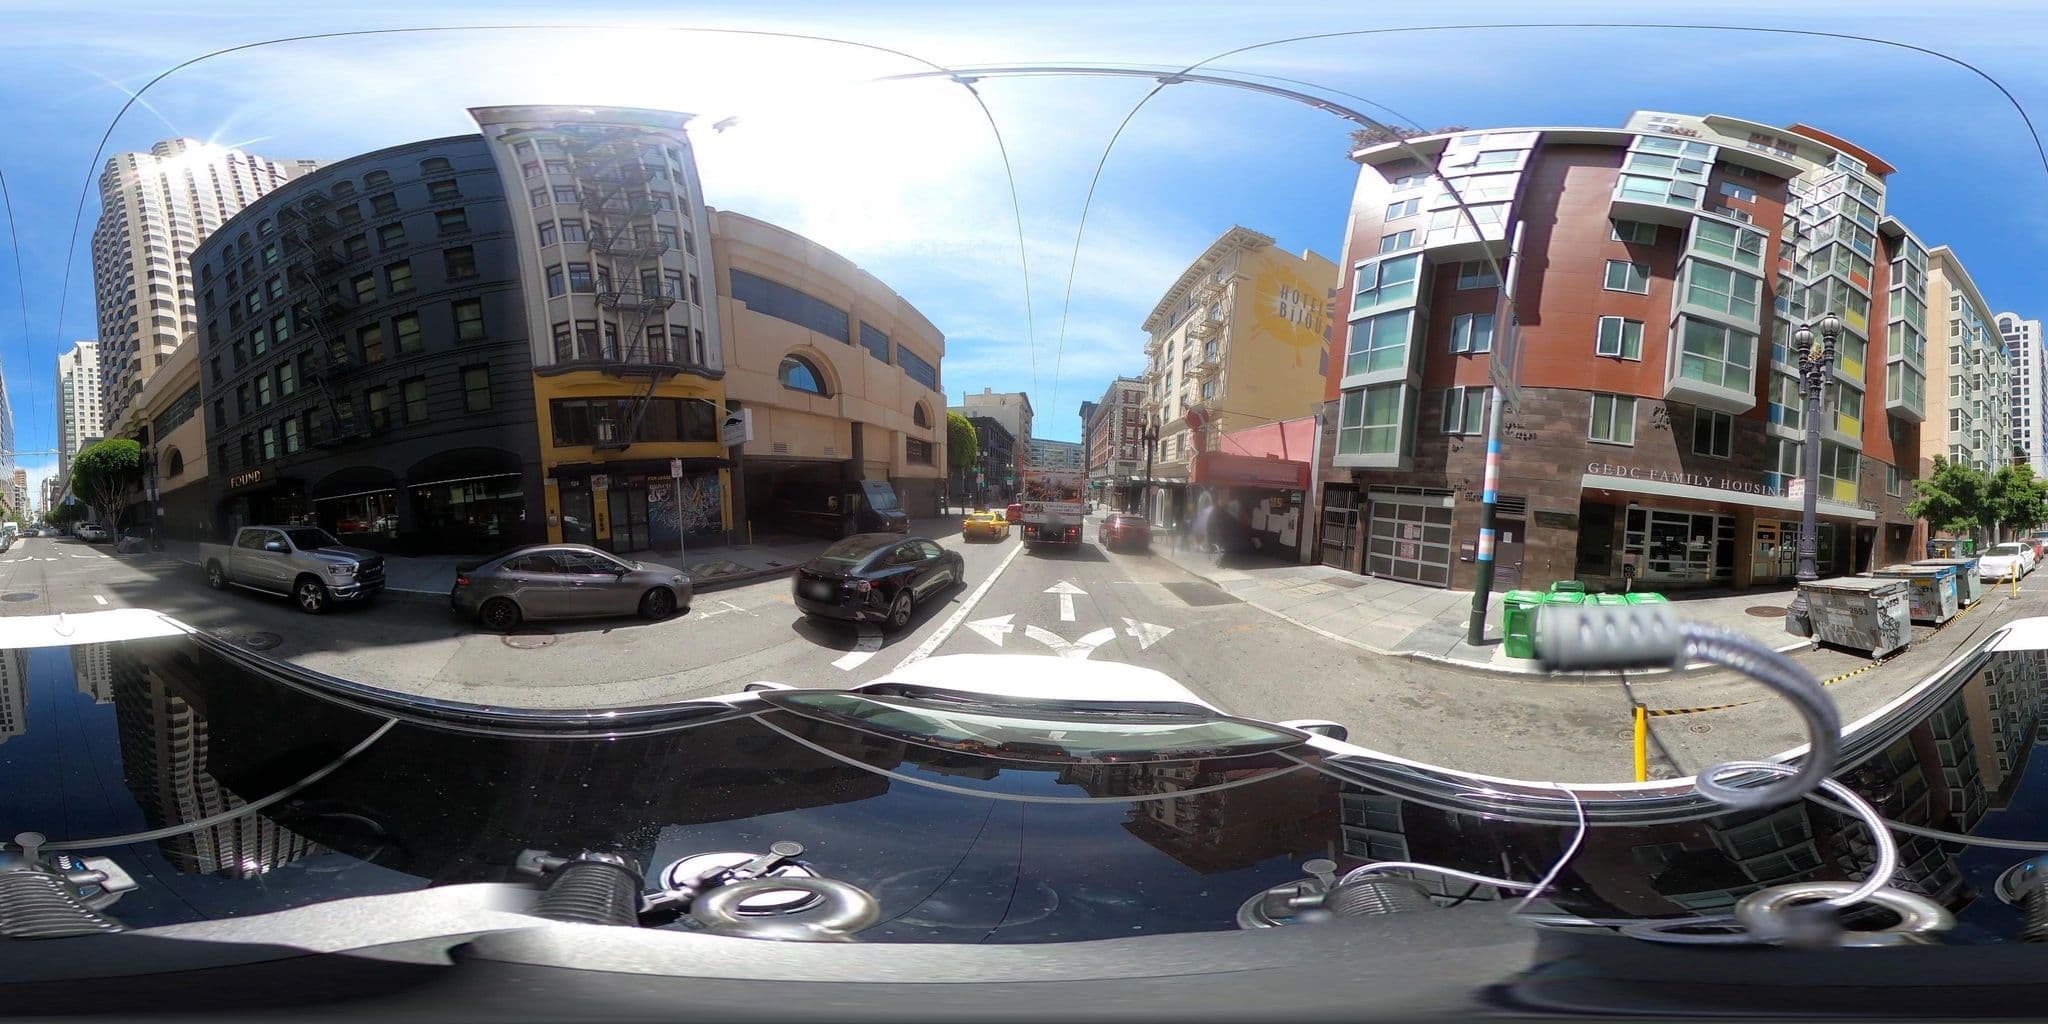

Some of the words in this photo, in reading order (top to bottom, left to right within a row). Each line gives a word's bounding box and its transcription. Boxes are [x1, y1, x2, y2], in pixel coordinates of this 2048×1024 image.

[1280, 284, 1323, 317] HOTEL
[230, 470, 261, 488] FOUND
[1588, 462, 1640, 478] GEDC
[1650, 469, 1713, 487] FAMILY
[1721, 478, 1786, 497] HOUSING
